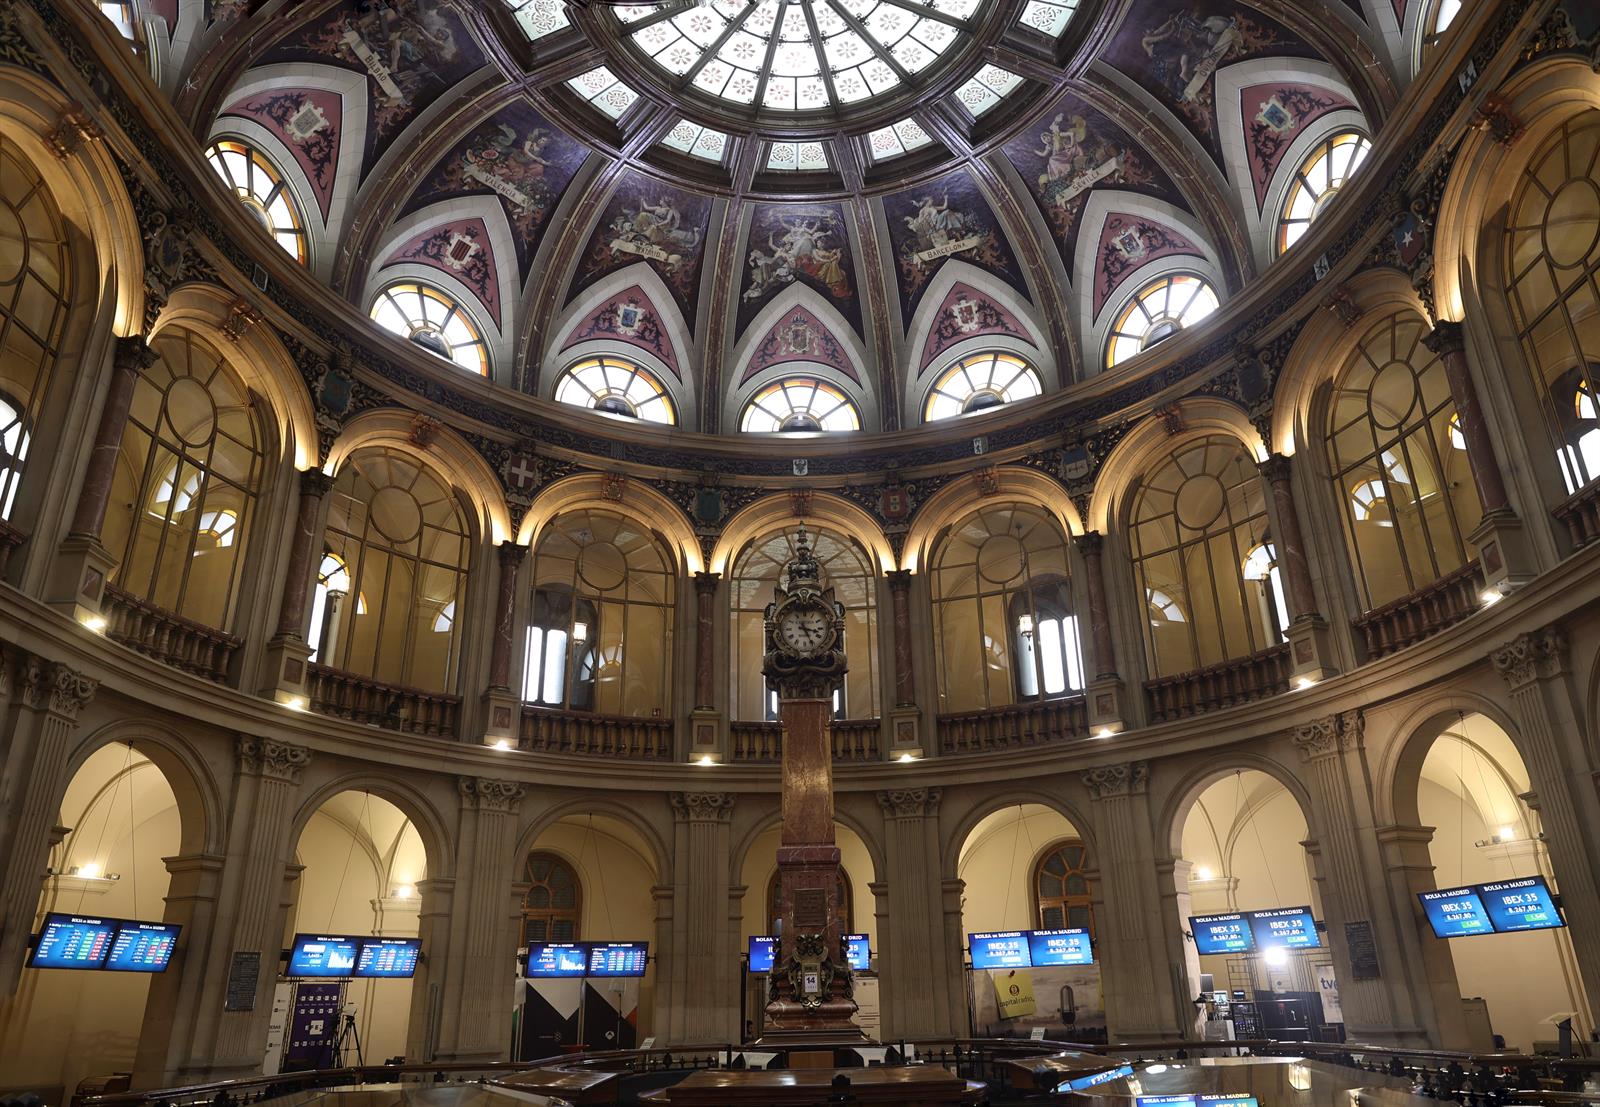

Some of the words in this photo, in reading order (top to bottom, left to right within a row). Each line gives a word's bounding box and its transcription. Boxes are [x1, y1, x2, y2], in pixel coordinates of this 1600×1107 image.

[365, 55, 387, 81] BILBAO
[485, 175, 516, 197] VALENCIA
[927, 242, 965, 258] BARCELONA
[1509, 880, 1536, 888] MADRID
[1447, 889, 1470, 897] MADRID
[1502, 895, 1524, 905] IBEX
[1525, 893, 1538, 902] 35
[1441, 903, 1461, 912] IBEX
[1461, 901, 1472, 910] 35
[1210, 926, 1228, 934] IBEX
[1230, 924, 1240, 932] 35
[1270, 921, 1289, 929] IBEX
[1291, 919, 1302, 927] 35
[988, 941, 1006, 950] IBEX
[1048, 938, 1067, 947] IBEX
[1069, 938, 1080, 946] 35
